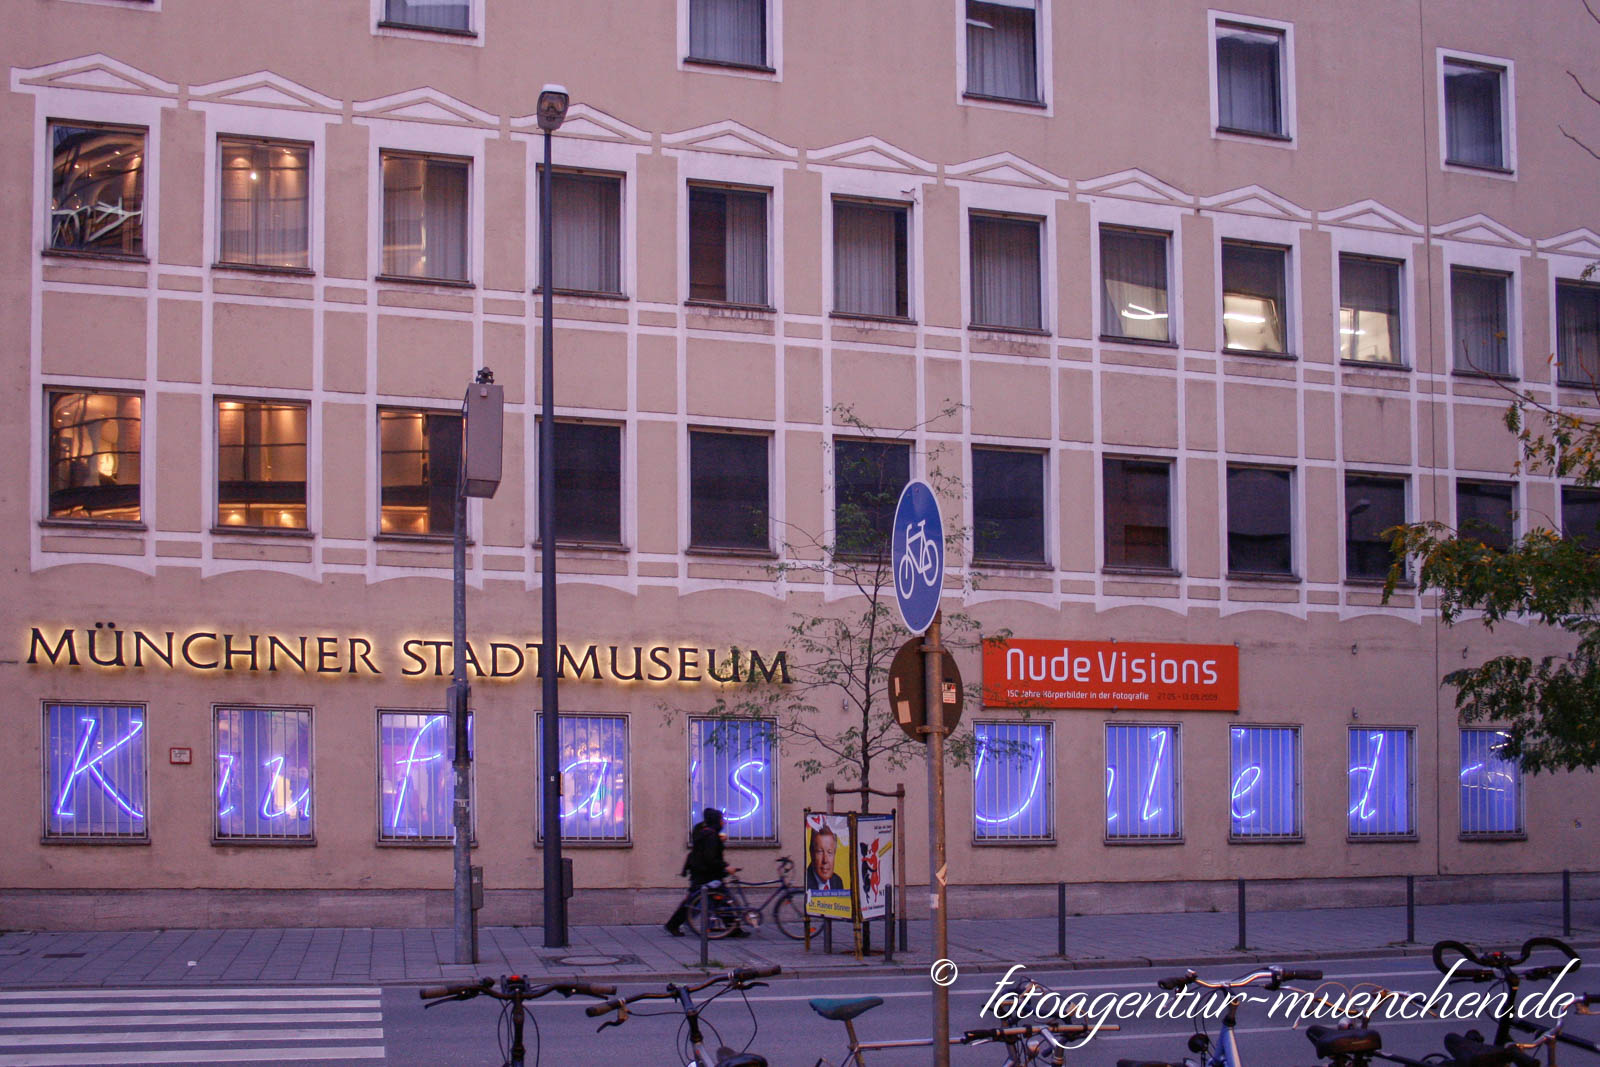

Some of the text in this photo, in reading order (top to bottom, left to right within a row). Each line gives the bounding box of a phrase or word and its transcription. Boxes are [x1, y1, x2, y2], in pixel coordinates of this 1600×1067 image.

[27, 622, 382, 674] MÜNCHNER
[1099, 692, 1111, 700] der
[1112, 692, 1150, 702] Fotografie
